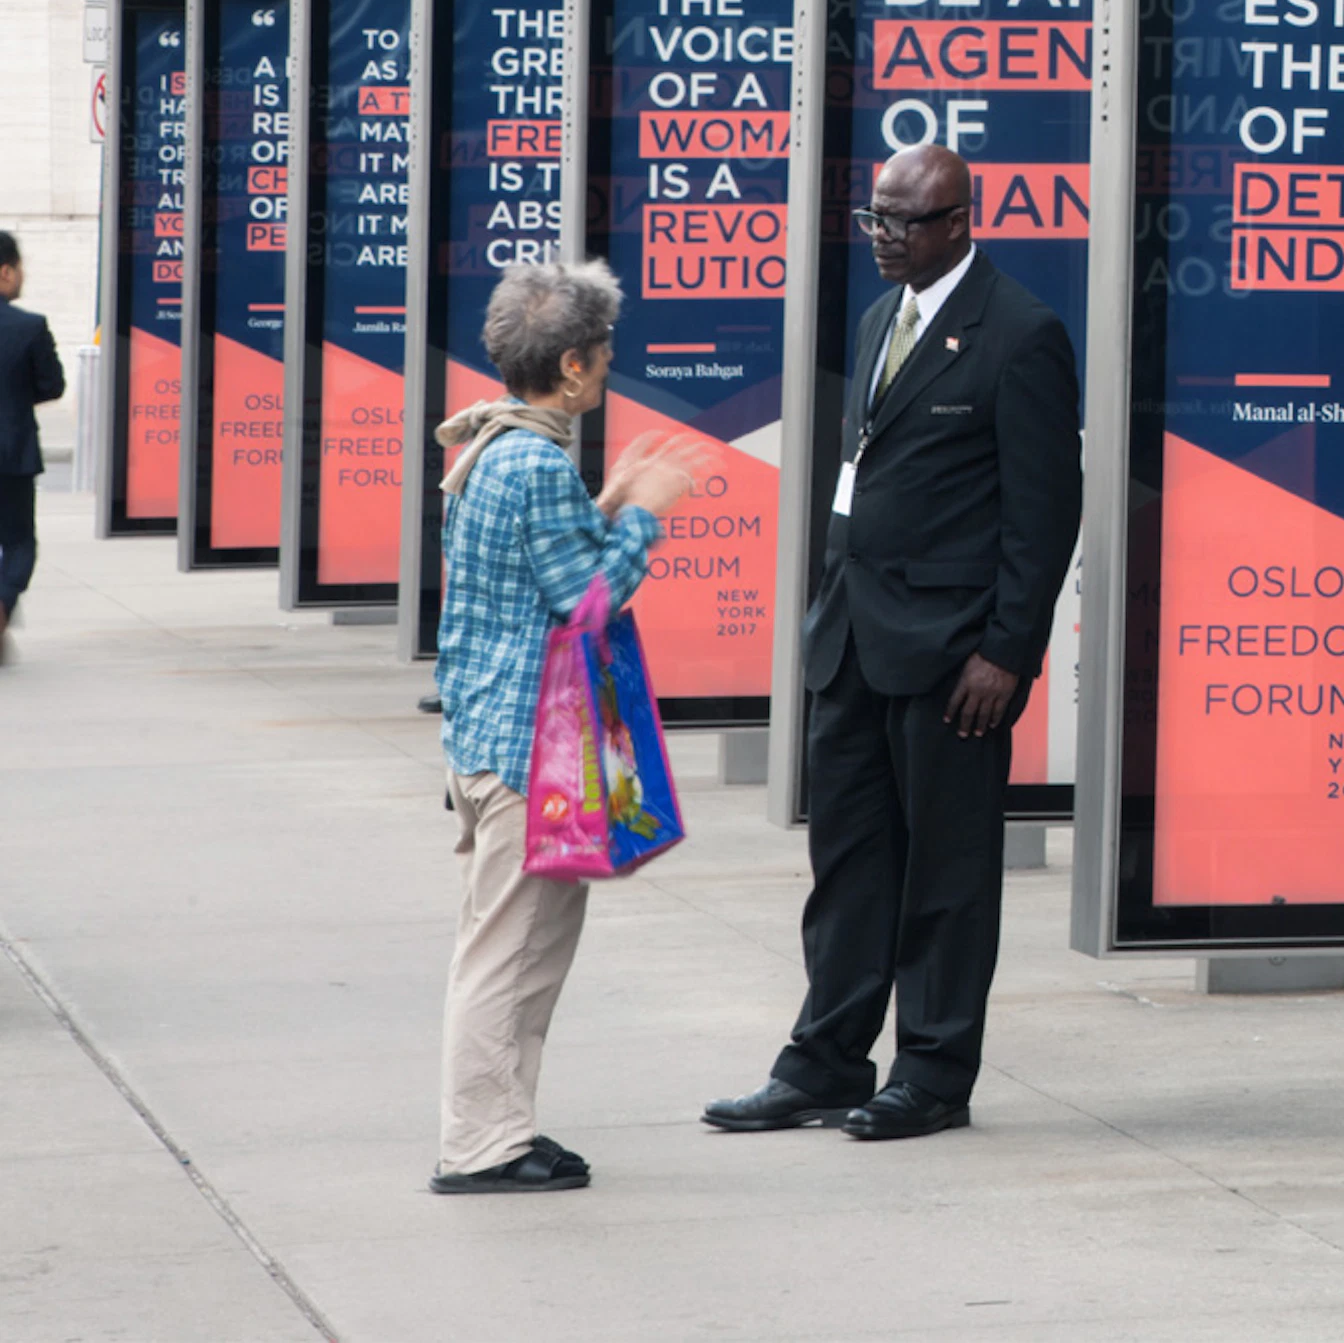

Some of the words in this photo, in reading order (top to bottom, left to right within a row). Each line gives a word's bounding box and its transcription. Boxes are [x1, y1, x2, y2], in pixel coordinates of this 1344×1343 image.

[492, 8, 564, 38] THE
[362, 29, 400, 50] TO
[650, 26, 796, 63] VOICE
[492, 46, 563, 78] GRE
[882, 27, 1092, 80] AGEN
[253, 56, 275, 78] A
[362, 60, 398, 80] AS
[254, 84, 280, 106] IS
[362, 91, 380, 111] A
[649, 72, 717, 108] OF
[733, 73, 768, 108] A
[253, 112, 289, 135] RE
[881, 99, 988, 152] OF
[1239, 105, 1327, 155] OF
[491, 124, 562, 152] FRE
[252, 140, 289, 162] OF
[359, 153, 384, 173] IT
[252, 169, 288, 190] CH
[489, 163, 523, 191] IS
[649, 164, 690, 199] IS
[706, 164, 742, 199] A
[358, 183, 409, 204] ARE
[250, 197, 288, 219] OF
[487, 201, 561, 230] ABS
[358, 214, 382, 235] IT
[250, 226, 286, 246] PE
[356, 245, 408, 266] ARE
[649, 256, 786, 290] LUTIO
[353, 321, 390, 333] Jamila
[646, 364, 692, 380] Soraya
[695, 364, 744, 381] Bahgat
[1233, 403, 1293, 422] Manal
[233, 449, 283, 465] FOR
[647, 555, 740, 581] ORUM
[1228, 566, 1344, 598] OSLO
[717, 590, 758, 601] NEW
[717, 606, 766, 618] YORK
[717, 623, 756, 636] 2017
